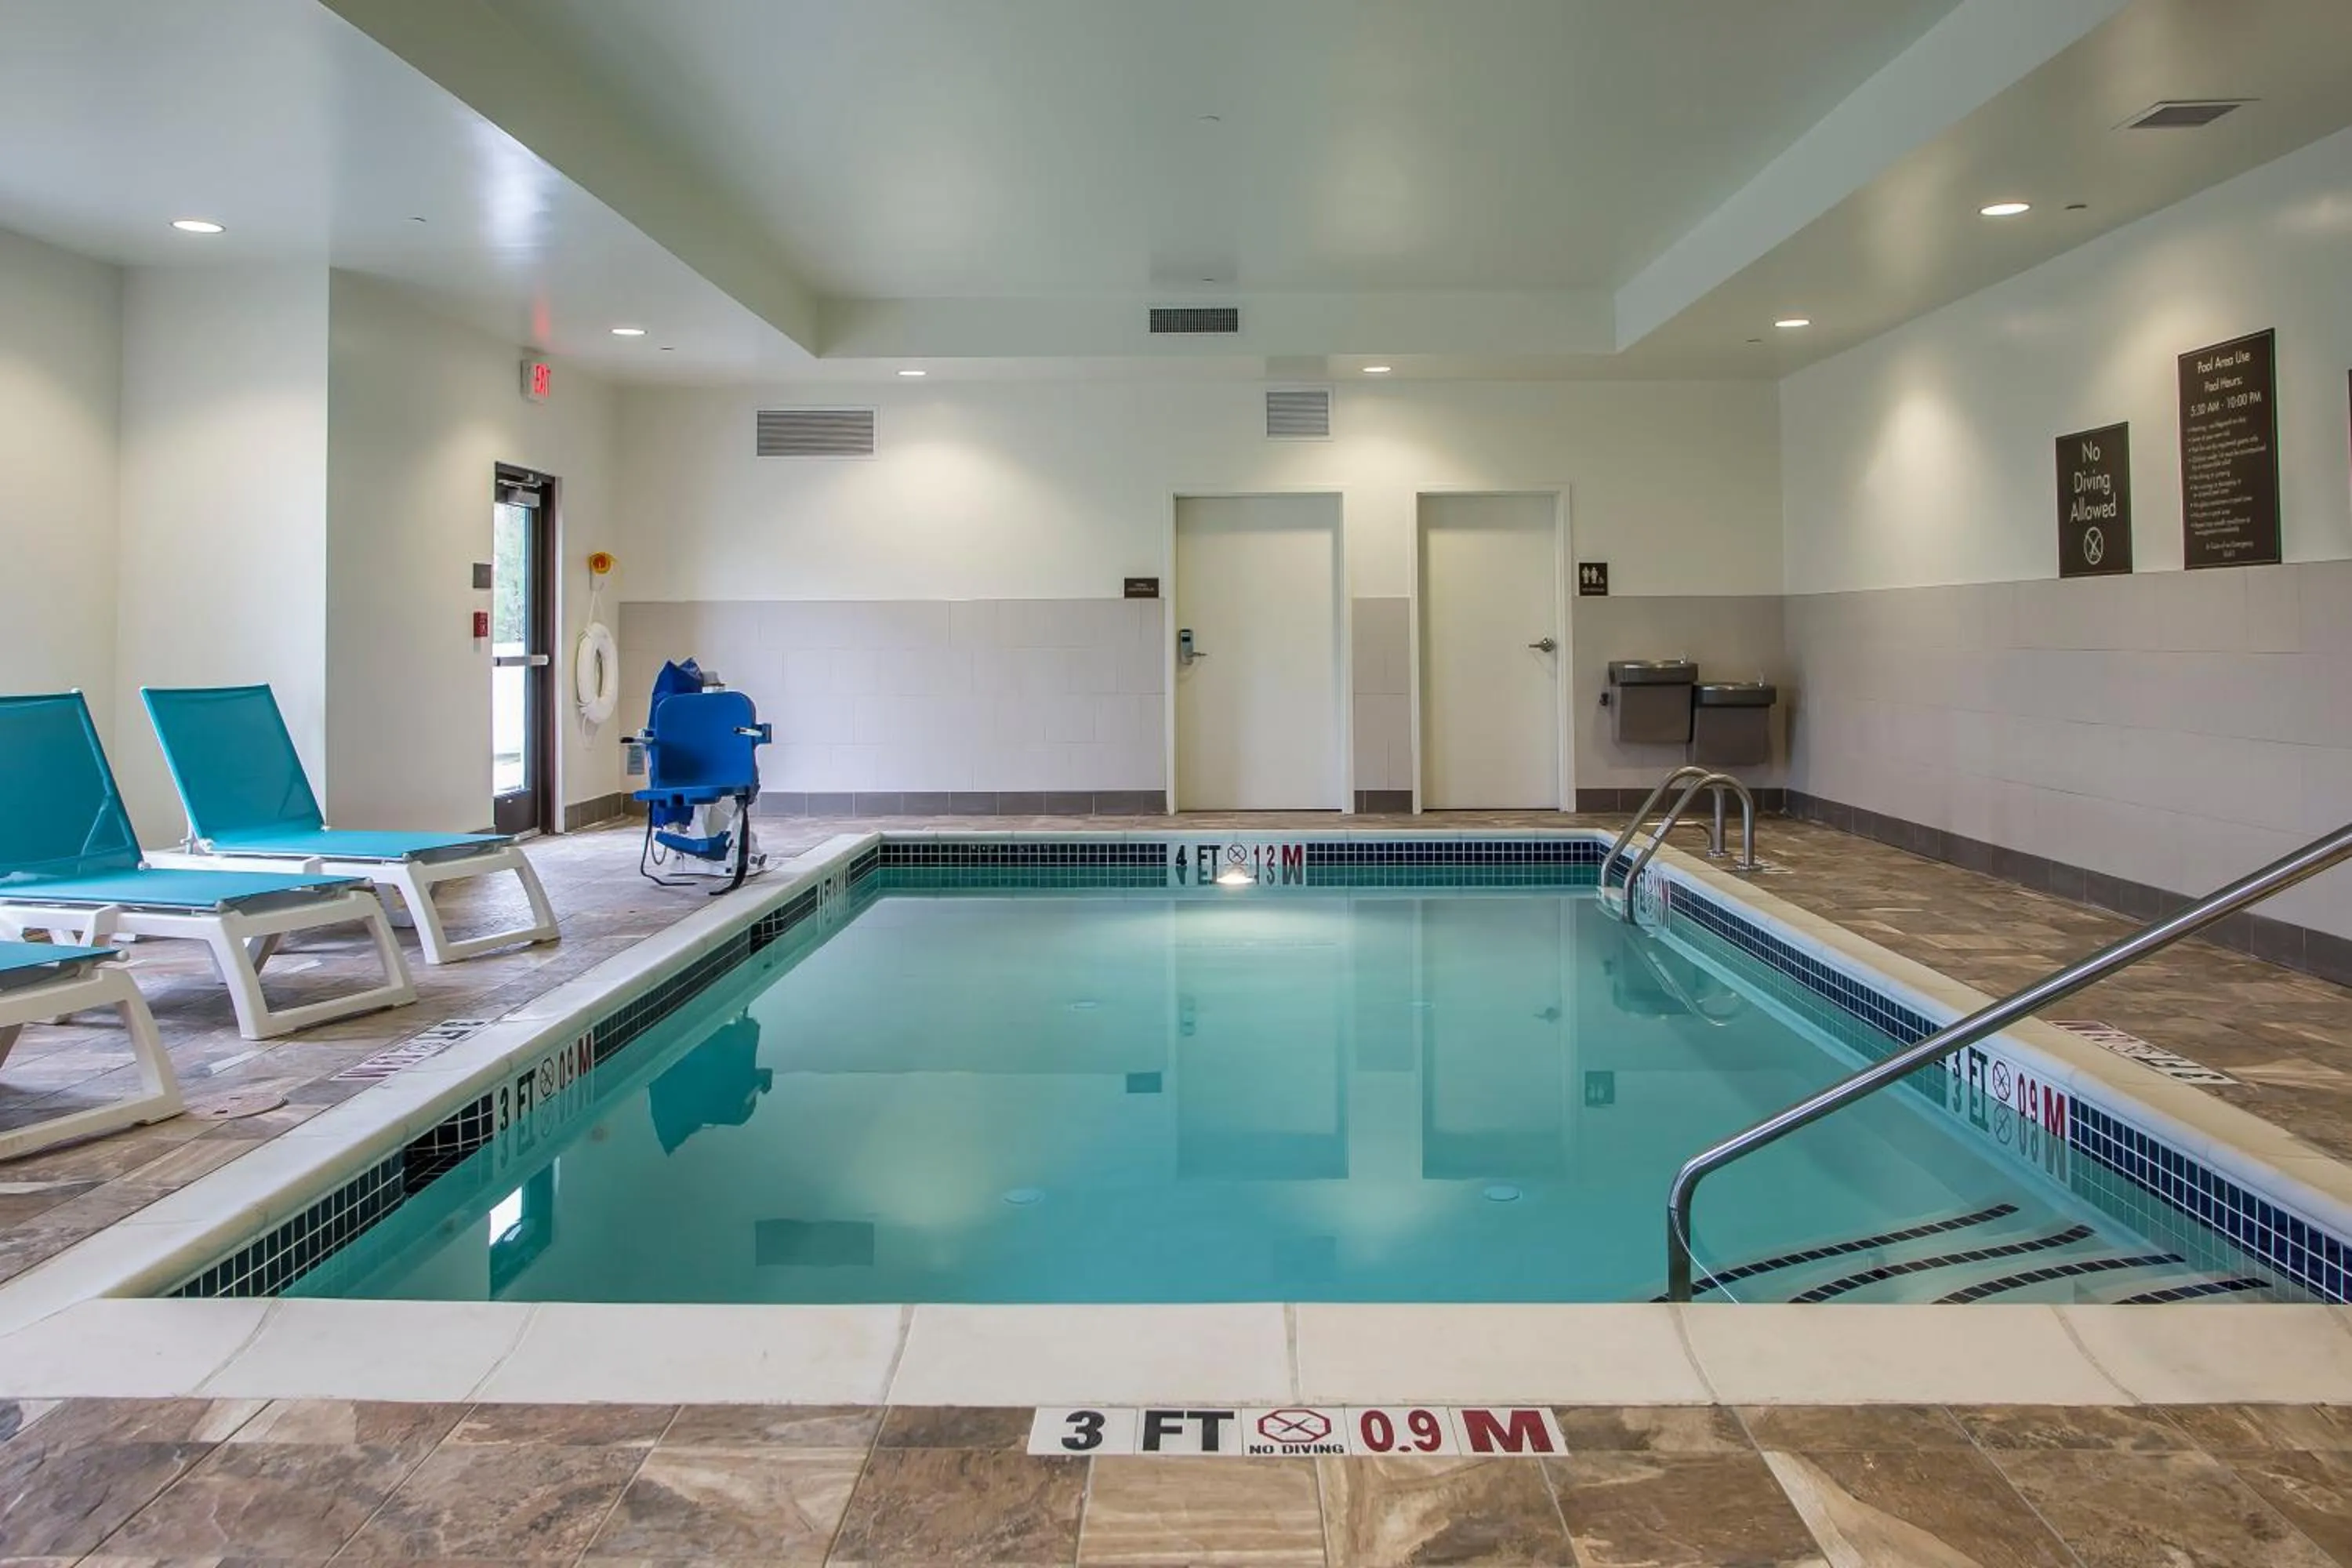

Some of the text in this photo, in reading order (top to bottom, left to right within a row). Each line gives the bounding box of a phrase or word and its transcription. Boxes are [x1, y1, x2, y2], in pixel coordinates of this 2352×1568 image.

[2198, 350, 2250, 374] Pool Area Use
[2207, 401, 2220, 413] AM
[2227, 394, 2248, 408] 10:00
[2249, 391, 2262, 404] PM
[2082, 440, 2100, 463] No
[2074, 470, 2111, 495] Diving
[2070, 492, 2116, 523] Allowed
[1175, 844, 1188, 866] 4
[1197, 844, 1221, 866] FT
[1282, 844, 1303, 866] M
[499, 1086, 509, 1131] 3
[517, 1068, 536, 1120] FT
[578, 1031, 591, 1077] M
[1969, 1045, 1987, 1094] FT
[2044, 1085, 2065, 1141] M
[1061, 1410, 1555, 1452] 3 FT 0.9 M
[1249, 1444, 1345, 1454] NO DIVING
